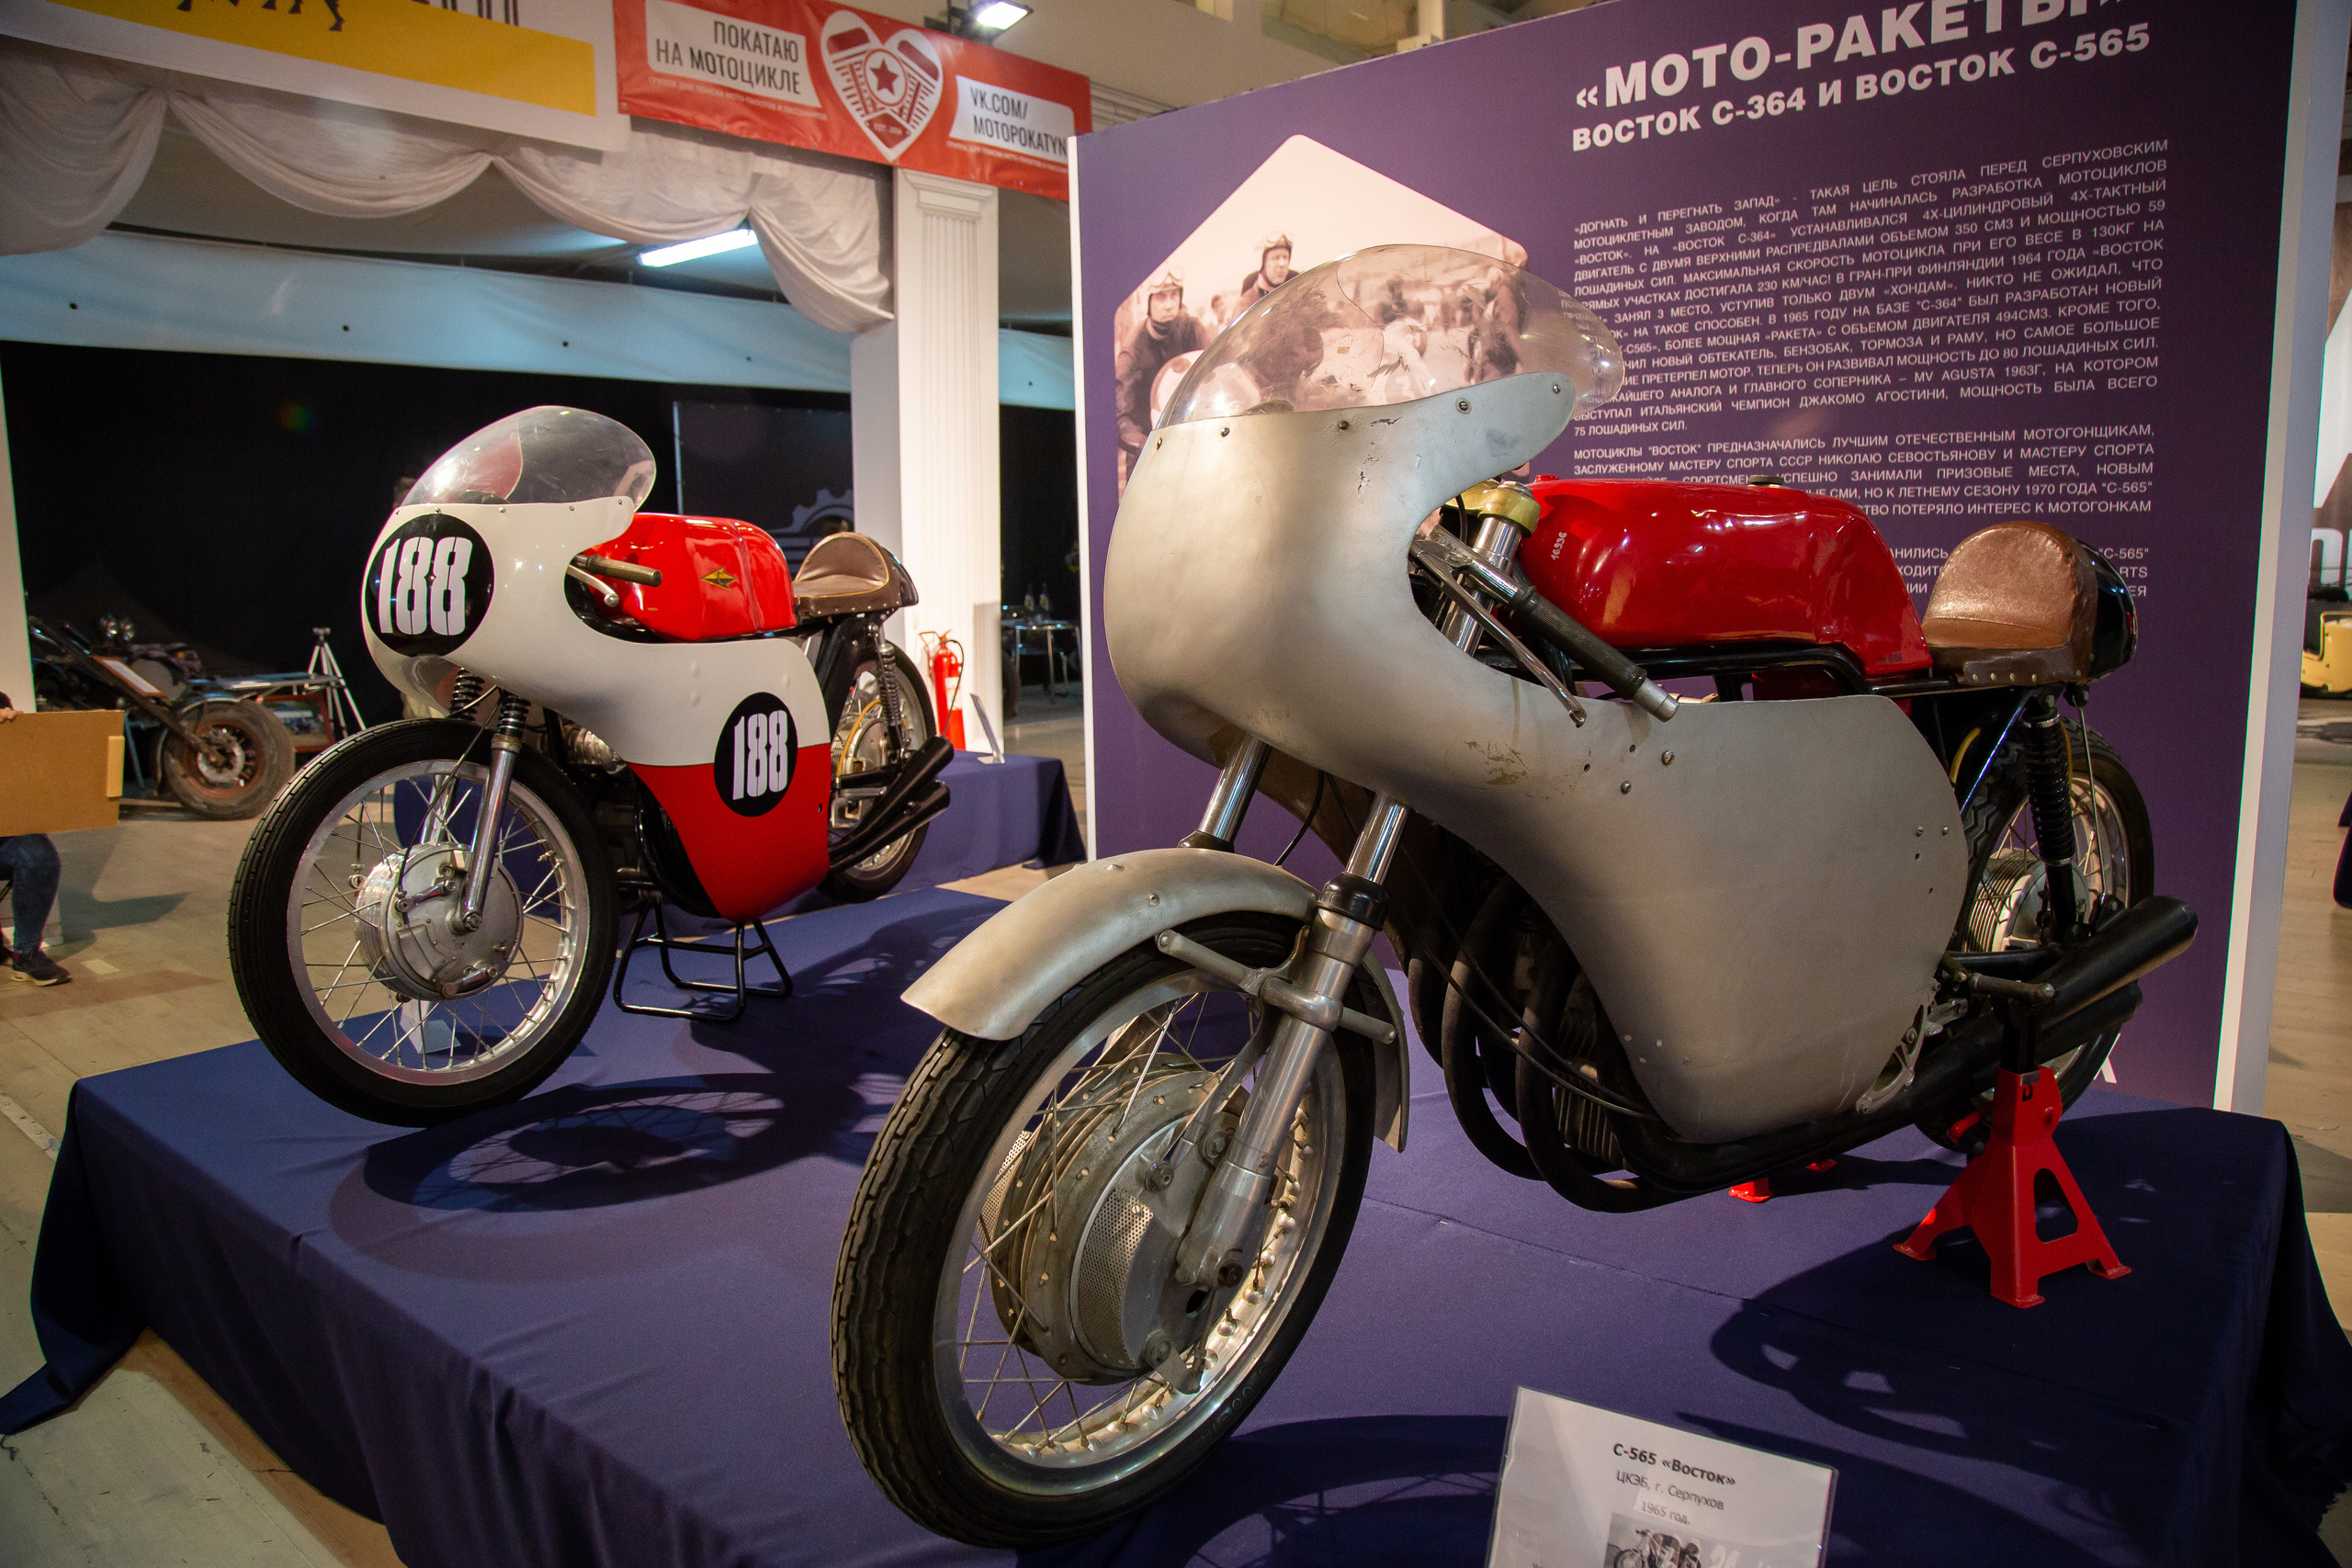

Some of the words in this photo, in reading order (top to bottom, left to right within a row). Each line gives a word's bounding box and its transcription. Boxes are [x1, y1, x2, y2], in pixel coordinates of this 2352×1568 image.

[713, 19, 799, 63] ПОКАТАЮ
[655, 38, 683, 67] НА
[688, 45, 801, 96] МОТОЦИКЛЕ
[1572, 105, 1702, 152] ВОСТОК
[1711, 86, 1806, 127] С-364
[1818, 78, 1842, 107] И
[1855, 47, 2016, 101] ВОСТОК
[2030, 22, 2150, 70] С-565
[969, 85, 1029, 121] VK.COM/
[1657, 203, 1722, 222] ПЕРЕГНАТЬ
[1809, 184, 1849, 200] ТАКАЯ
[1862, 178, 1897, 193] ЦЕЛЬ
[1910, 168, 1965, 186] СТОЯЛА
[1980, 159, 2027, 177] ПЕРЕД
[2041, 138, 2167, 168] СЕРПУХОВСКИМ
[1573, 226, 1673, 249] МОТОЦИКЛЕТНЫМ
[1758, 209, 1798, 224] КОГДА
[1811, 203, 1836, 217] ТАМ
[1849, 191, 1937, 212] НАЧИНАЛАСЬ
[1951, 176, 2042, 199] РАЗРАБОТКА
[2058, 159, 2166, 185] МОТОЦИКЛОВ
[1573, 264, 1634, 282] ДВИГАТЕЛЬ
[1651, 256, 1690, 273] ДВУМЯ
[1696, 247, 1760, 265] ВЕРХНИМИ
[1765, 234, 1873, 257] РАСПРЕДВАЛАМИ
[1879, 225, 1948, 244] ОБЪЕМОМ
[1954, 222, 1977, 235] 350
[1984, 217, 2013, 231] СМ3
[2037, 202, 2140, 225] МОЩНОСТЬЮ
[2148, 199, 2165, 212] 59
[1643, 244, 1659, 256] НА
[1790, 212, 1907, 237] УСТАНАВЛИВАЛСЯ
[1574, 278, 1644, 296] ЛОШАДИНЫХ
[1683, 262, 1780, 283] МАКСИМАЛЬНАЯ
[1786, 254, 1854, 271] СКОРОСТЬ
[1862, 244, 1944, 263] МОТОЦИКЛА
[1952, 239, 1980, 253] ПРИ
[1989, 235, 2016, 249] ЕГО
[2025, 230, 2062, 245] ВЕСЕ
[2092, 222, 2134, 238] 130КГ
[2143, 218, 2164, 232] НА
[1623, 290, 1680, 307] УЧАСТКАХ
[1684, 282, 1753, 301] ДОСТИГАЛА
[1756, 279, 1777, 292] 230
[1849, 265, 1911, 282] ГРАН-ПРИ
[1917, 255, 2003, 275] ФИНЛЯНДИИ
[2011, 252, 2041, 265] 1964
[2047, 247, 2085, 262] ГОДА
[1614, 309, 1650, 323] ЗАНЯЛ
[1719, 296, 1774, 312] УСТУПИВ
[1781, 291, 1831, 306] ТОЛЬКО
[1838, 286, 1875, 302] ДВУМ
[1966, 273, 2013, 288] НИКТО
[2022, 270, 2041, 283] НЕ
[2131, 257, 2162, 271] ЧТО
[1633, 326, 1648, 337] НА
[1653, 322, 1689, 335] ТАКОЕ
[1782, 310, 1808, 323] 1965
[1814, 307, 1847, 320] ГОДУ
[1852, 305, 1870, 316] НА
[1876, 301, 1909, 315] БАЗЕ
[1968, 293, 1998, 306] БЫЛ
[2005, 284, 2098, 303] РАЗРАБОТАН
[2105, 275, 2161, 294] НОВЫЙ
[1651, 353, 1692, 367] НОВЫЙ
[1860, 335, 1923, 351] ТОРМОЗА
[1995, 328, 2015, 341] НО
[2023, 323, 2074, 338] САМОЕ
[2083, 316, 2160, 334] БОЛЬШОЕ
[1664, 336, 1702, 350] БОЛЕЕ
[1706, 331, 1759, 346] МОЩНАЯ
[1840, 319, 1906, 335] ОБЪЕМОМ
[1911, 311, 1989, 331] ДВИГАТЕЛЯ
[2058, 301, 2109, 317] КРОМЕ
[1641, 369, 1706, 384] ПРЕТЕРПЕЛ
[1757, 362, 1803, 375] ТЕПЕРЬ
[1805, 360, 1824, 372] ОН
[1826, 355, 1893, 370] РАЗВИВАЛ
[1896, 350, 1975, 366] МОЩНОСТЬ
[1978, 348, 1999, 362] ДО
[2002, 346, 2018, 359] 80
[2021, 339, 2118, 357] ЛОШАДИНЫХ
[1669, 385, 1722, 398] АНАЛОГА
[1743, 378, 1806, 393] ГЛАВНОГО
[1813, 373, 1891, 389] СОПЕРНИКА
[1914, 370, 1933, 382] MV
[1941, 367, 1994, 381] AGUSTA
[2054, 361, 2074, 374] НА
[2083, 355, 2157, 372] КОТОРОМ
[1639, 399, 1721, 416] ИТАЛЬЯНСКИЙ
[1731, 397, 1789, 410] ЧЕМПИОН
[1798, 392, 1864, 408] ДЖАКОМО
[1959, 382, 2041, 398] МОЩНОСТЬ
[2053, 378, 2095, 393] БЫЛА
[2107, 375, 2157, 389] ВСЕГО
[1573, 446, 1642, 459] МОТОЦИКЛЫ
[1707, 437, 1825, 453] ПРЕДНАЗНАЧАЛИСЬ
[1831, 434, 1887, 448] ЛУЧШИМ
[1895, 429, 2015, 445] ОТЕЧЕСТВЕННЫМ
[1574, 426, 1585, 436] 75
[1587, 421, 1658, 436] ЛОШАДИНЫХ
[1573, 461, 1664, 475] ЗАСЛУЖЕННОМУ
[1668, 458, 1721, 471] МАСТЕРУ
[1726, 456, 1773, 469] СПОРТА
[1778, 455, 1812, 467] СССР
[1818, 452, 1881, 465] НИКОЛАЮ
[1887, 448, 1996, 463] СЕВОСТЬЯНОВУ
[2019, 445, 2086, 459] МАСТЕРУ
[2093, 442, 2154, 456] СПОРТА
[1850, 468, 1921, 481] ЗАНИМАЛИ
[1936, 465, 2012, 479] ПРИЗОВЫЕ
[2096, 461, 2153, 474] НОВЫМ
[1864, 486, 1883, 498] НО
[1897, 485, 1960, 498] ЛЕТНЕМУ
[1963, 484, 2020, 496] СЕЗОНУ
[2025, 483, 2055, 495] 1970
[2059, 482, 2097, 495] ГОДА
[1892, 502, 1963, 515] ПОТЕРЯЛО
[1967, 501, 2030, 514] ИНТЕРЕС
[2047, 499, 2151, 513] МОТОГОНКАМ
[377, 536, 473, 636] 188
[732, 709, 788, 800] 188
[1613, 1443, 1657, 1466] С-565
[1661, 1459, 1736, 1485] «Восток»
[1616, 1470, 1651, 1491] ЦКЭБ,
[1655, 1483, 1664, 1494] г.
[1668, 1484, 1724, 1510] Серпухов
